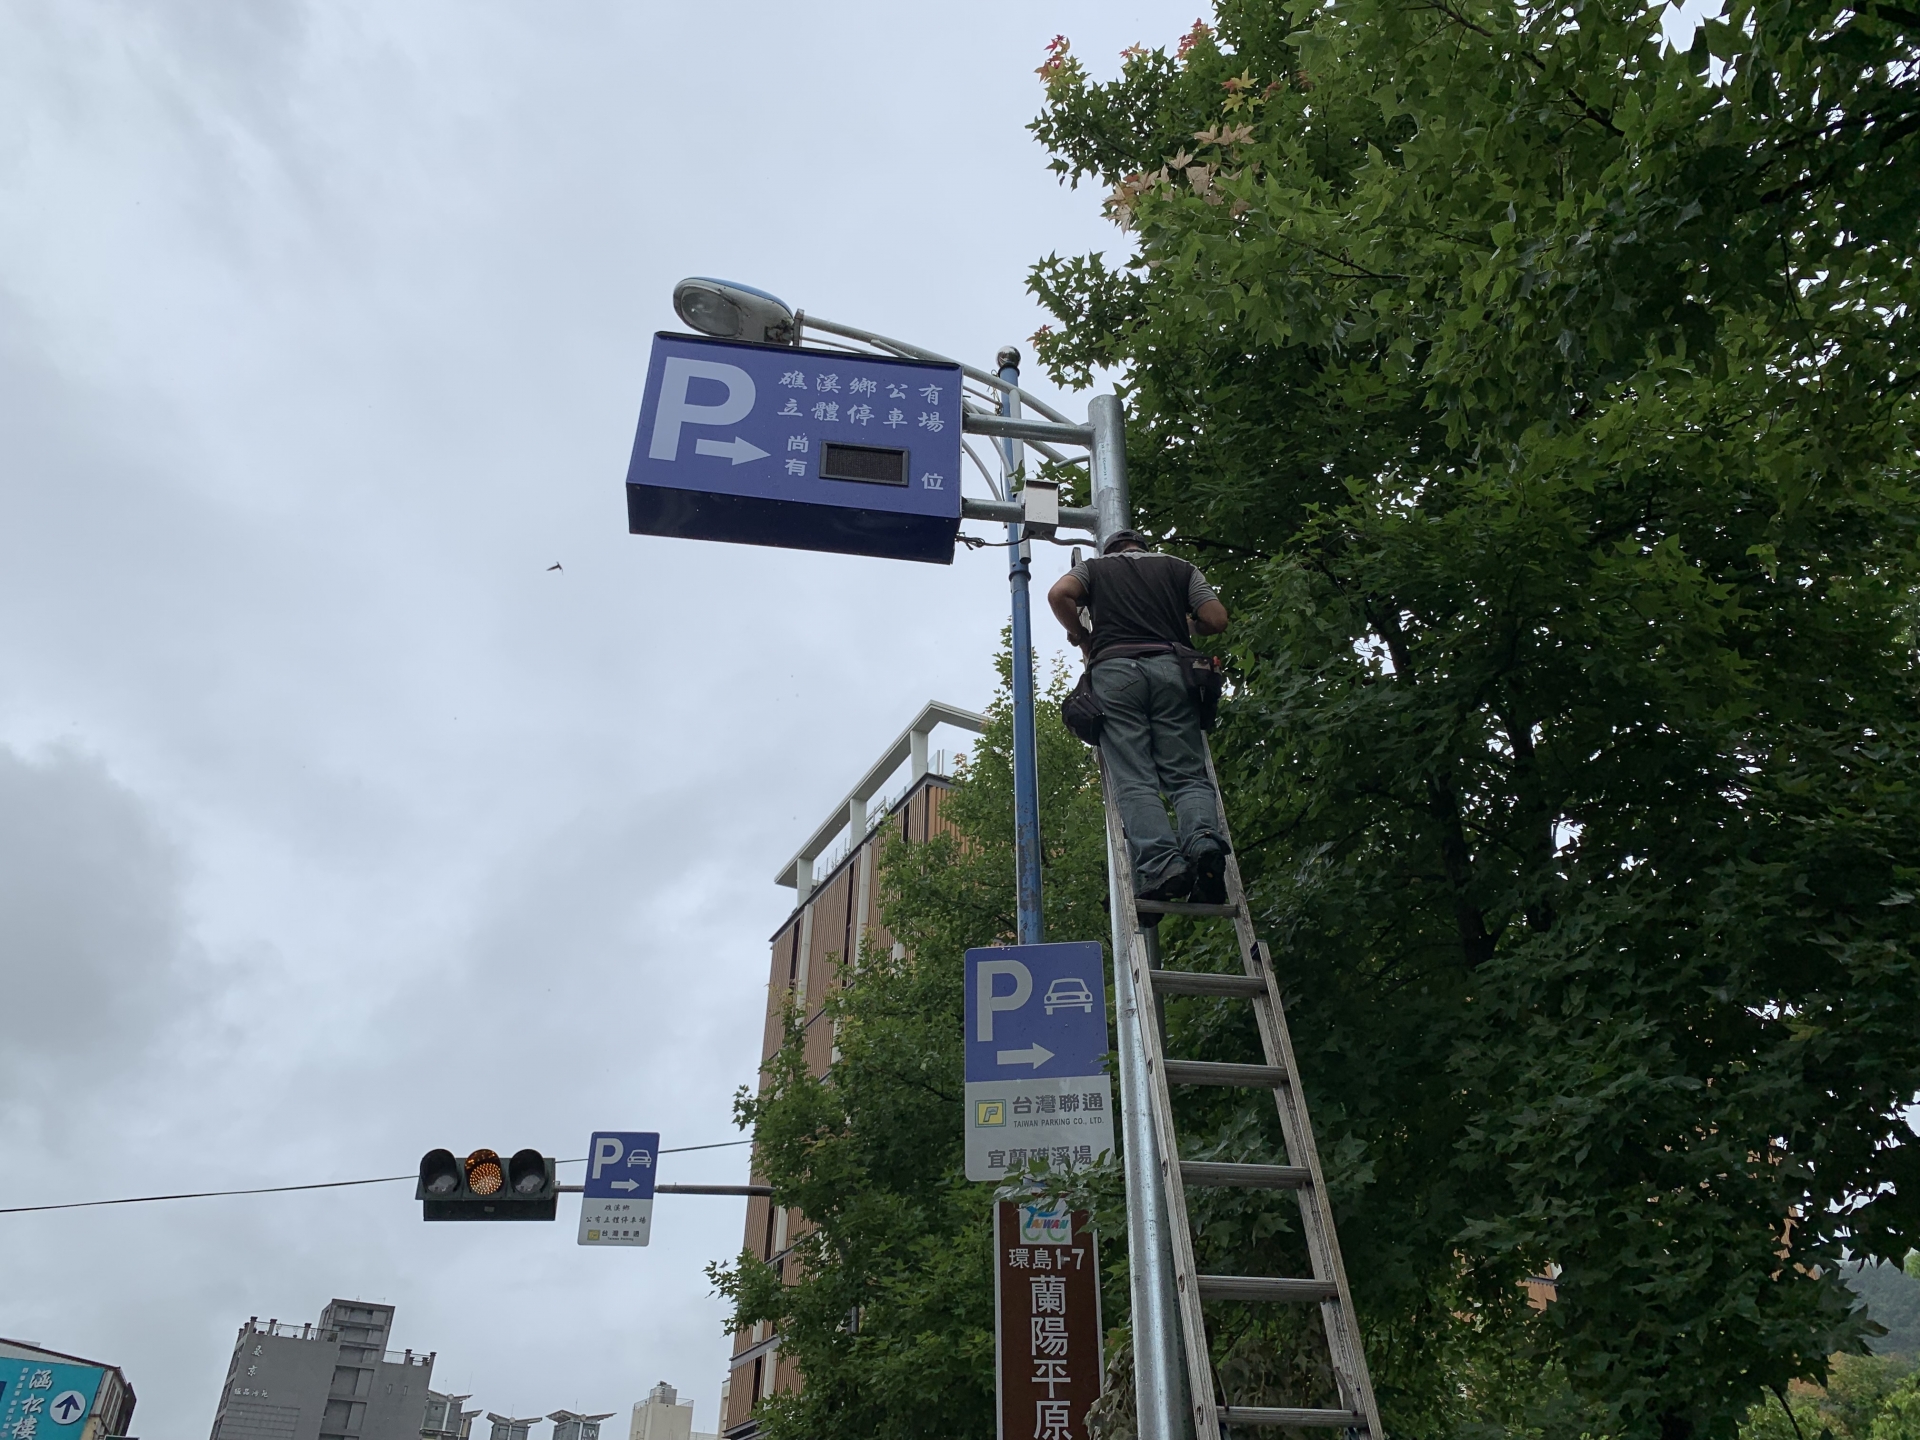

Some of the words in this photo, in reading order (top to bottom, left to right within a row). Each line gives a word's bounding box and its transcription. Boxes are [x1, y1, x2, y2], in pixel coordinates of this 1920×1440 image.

[778, 370, 943, 406] 礁溪鄉公有
[649, 356, 757, 462] P
[777, 398, 945, 433] 立體停車場
[785, 435, 809, 477] 尚有
[921, 472, 944, 490] 位
[977, 960, 1033, 1042] P
[1013, 1093, 1104, 1114] 台灣聯通
[1013, 1120, 1039, 1128] TAIWAN
[1041, 1118, 1071, 1127] PARKING
[1090, 1116, 1105, 1124] LTD.
[592, 1138, 624, 1179] P
[1029, 1274, 1073, 1440] 蘭陽平原
